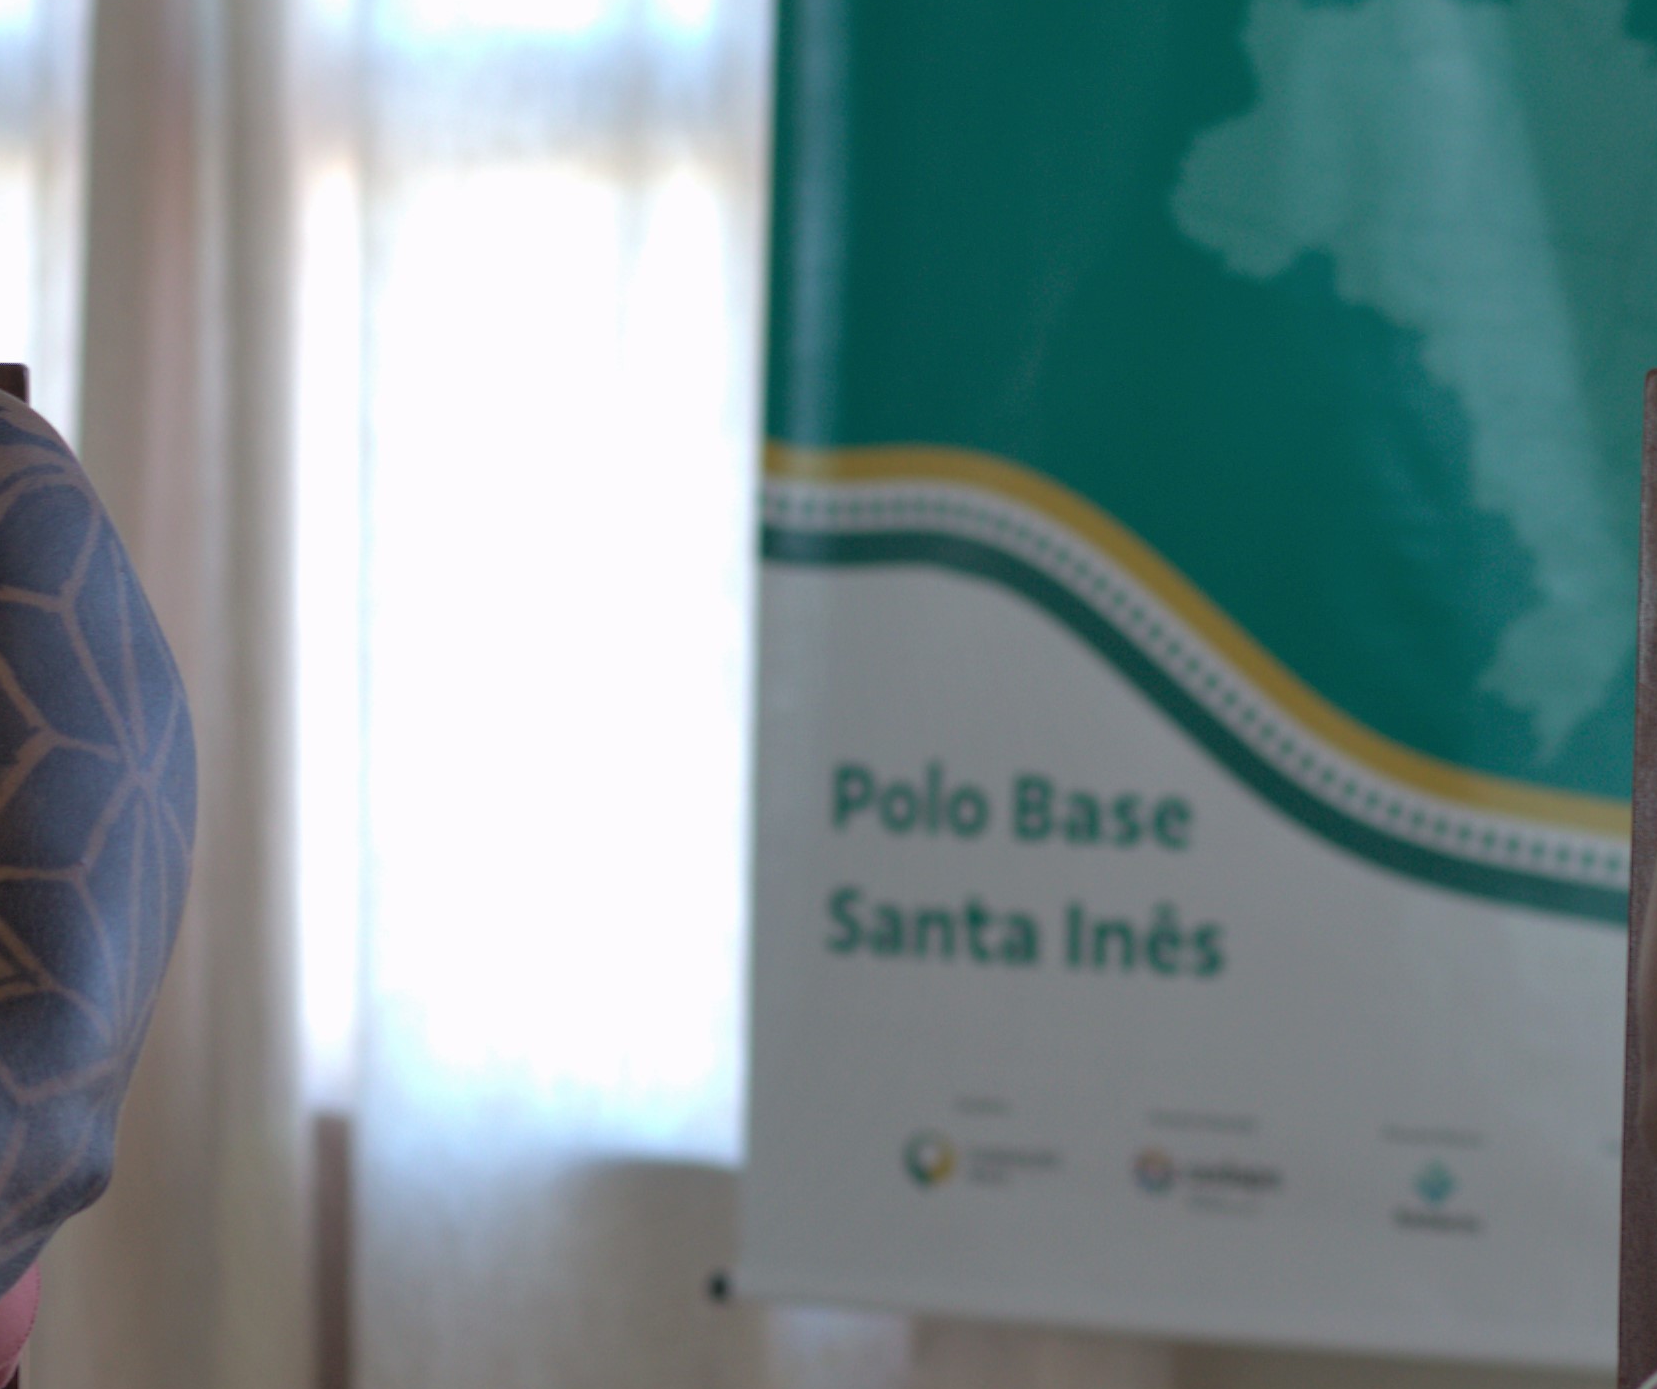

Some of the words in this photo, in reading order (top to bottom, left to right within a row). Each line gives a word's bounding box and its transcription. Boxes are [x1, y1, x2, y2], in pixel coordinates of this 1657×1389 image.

[832, 758, 990, 839] Polo
[1013, 772, 1192, 851] Base
[828, 885, 1040, 967] Santa
[1066, 899, 1225, 978] Inês
